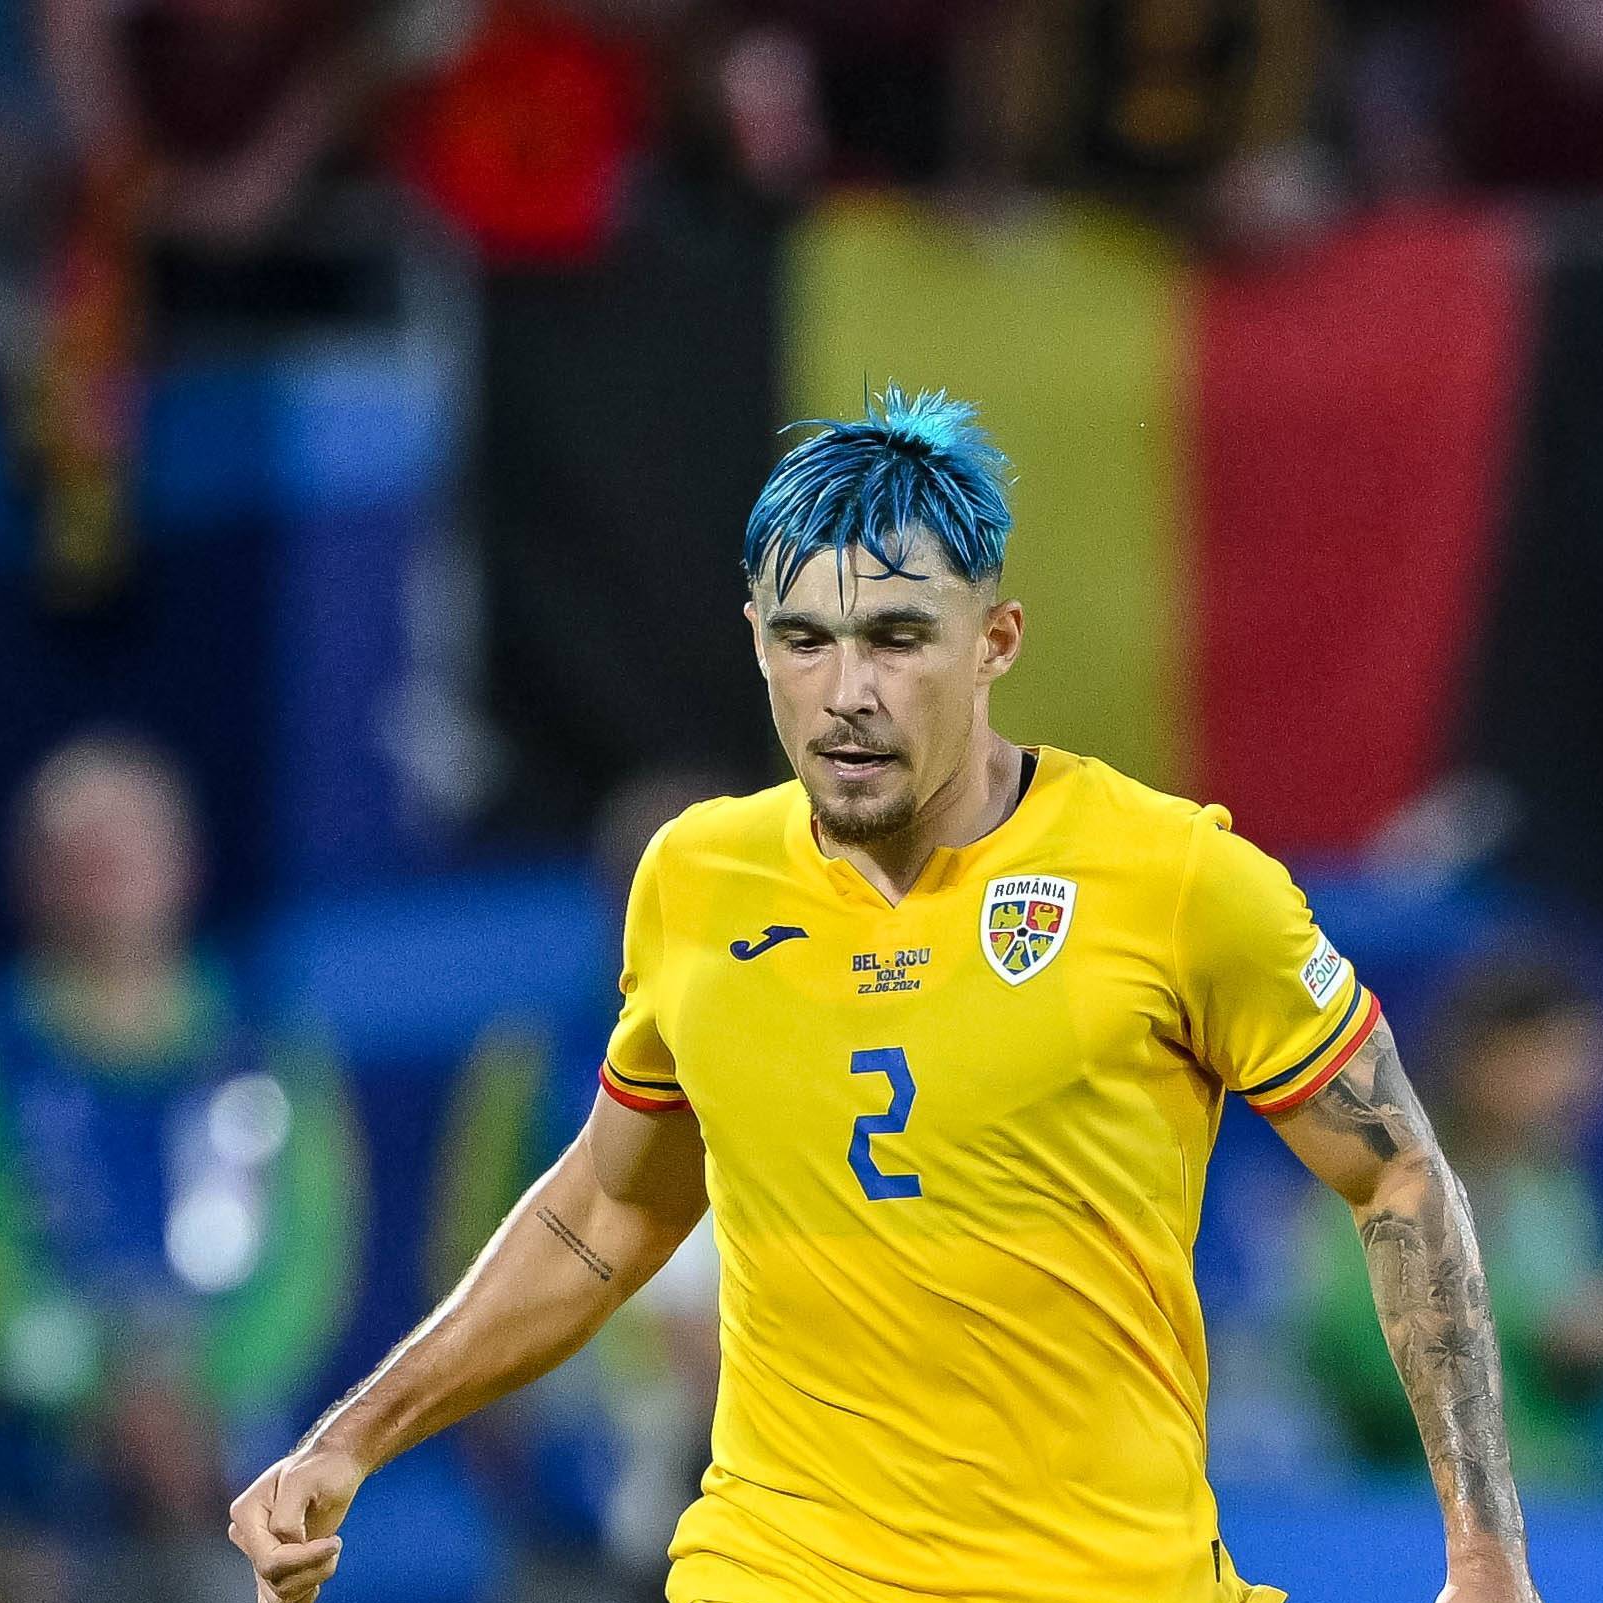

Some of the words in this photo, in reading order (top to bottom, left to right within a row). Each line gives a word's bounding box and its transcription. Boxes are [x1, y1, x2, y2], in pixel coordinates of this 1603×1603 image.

[994, 878, 1066, 900] ROMÂNIA
[852, 953, 881, 971] BEL
[894, 948, 931, 967] ROU
[847, 1046, 923, 1201] 2
